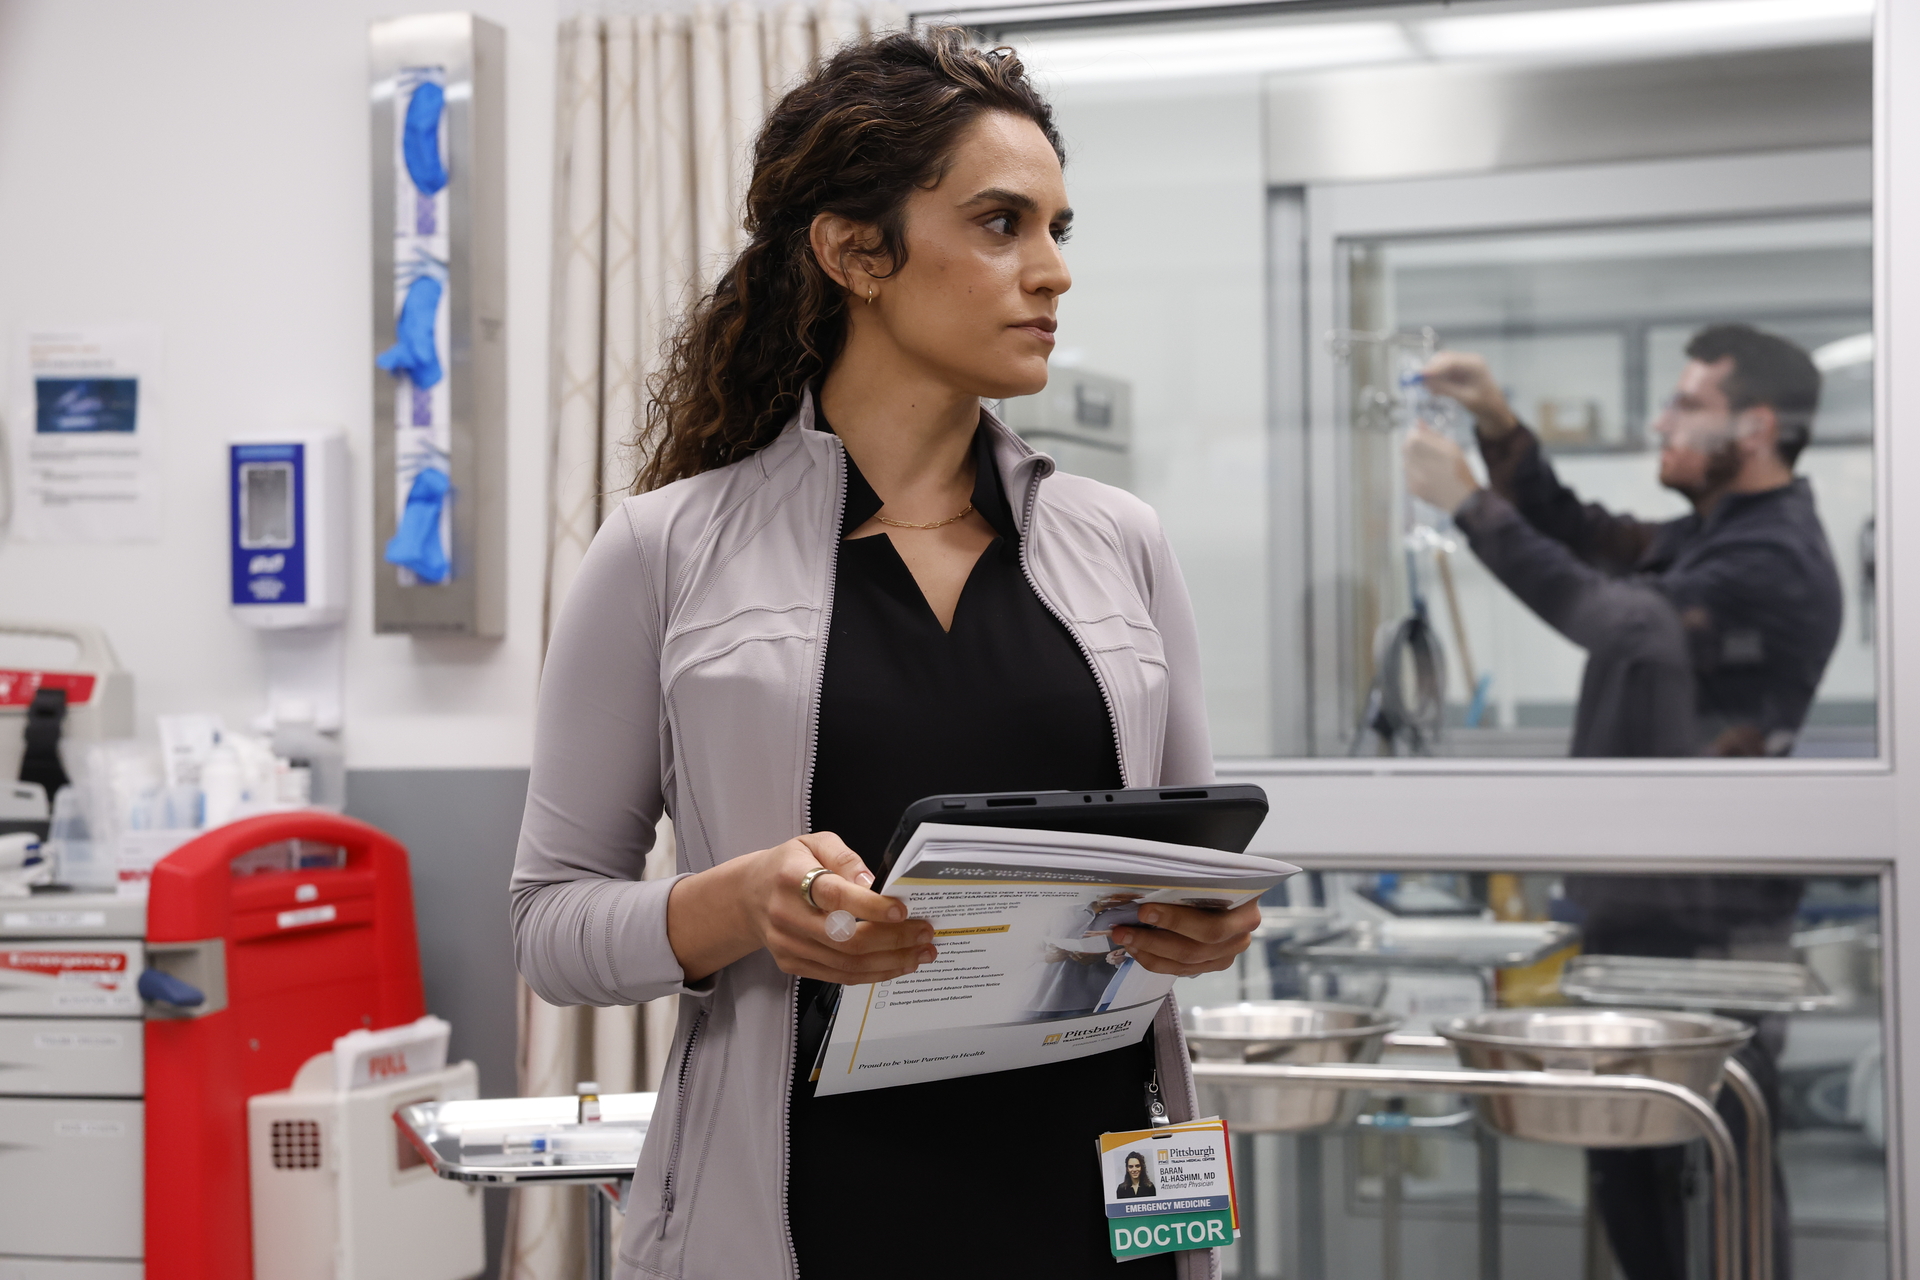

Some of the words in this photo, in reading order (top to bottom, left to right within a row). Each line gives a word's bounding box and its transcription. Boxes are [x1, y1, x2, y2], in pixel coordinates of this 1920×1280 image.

[1064, 1020, 1132, 1039] Pittsburgh
[859, 1062, 882, 1070] Proud
[959, 1050, 986, 1058] Health
[1170, 1146, 1215, 1157] Pittsburgh
[1160, 1167, 1183, 1175] BARAN
[1161, 1173, 1202, 1183] AL-HASHIMI,
[1204, 1172, 1215, 1180] MD
[1126, 1201, 1173, 1213] EMERGENCY
[1173, 1199, 1211, 1210] MEDICINE
[1114, 1219, 1225, 1250] DOCTOR
